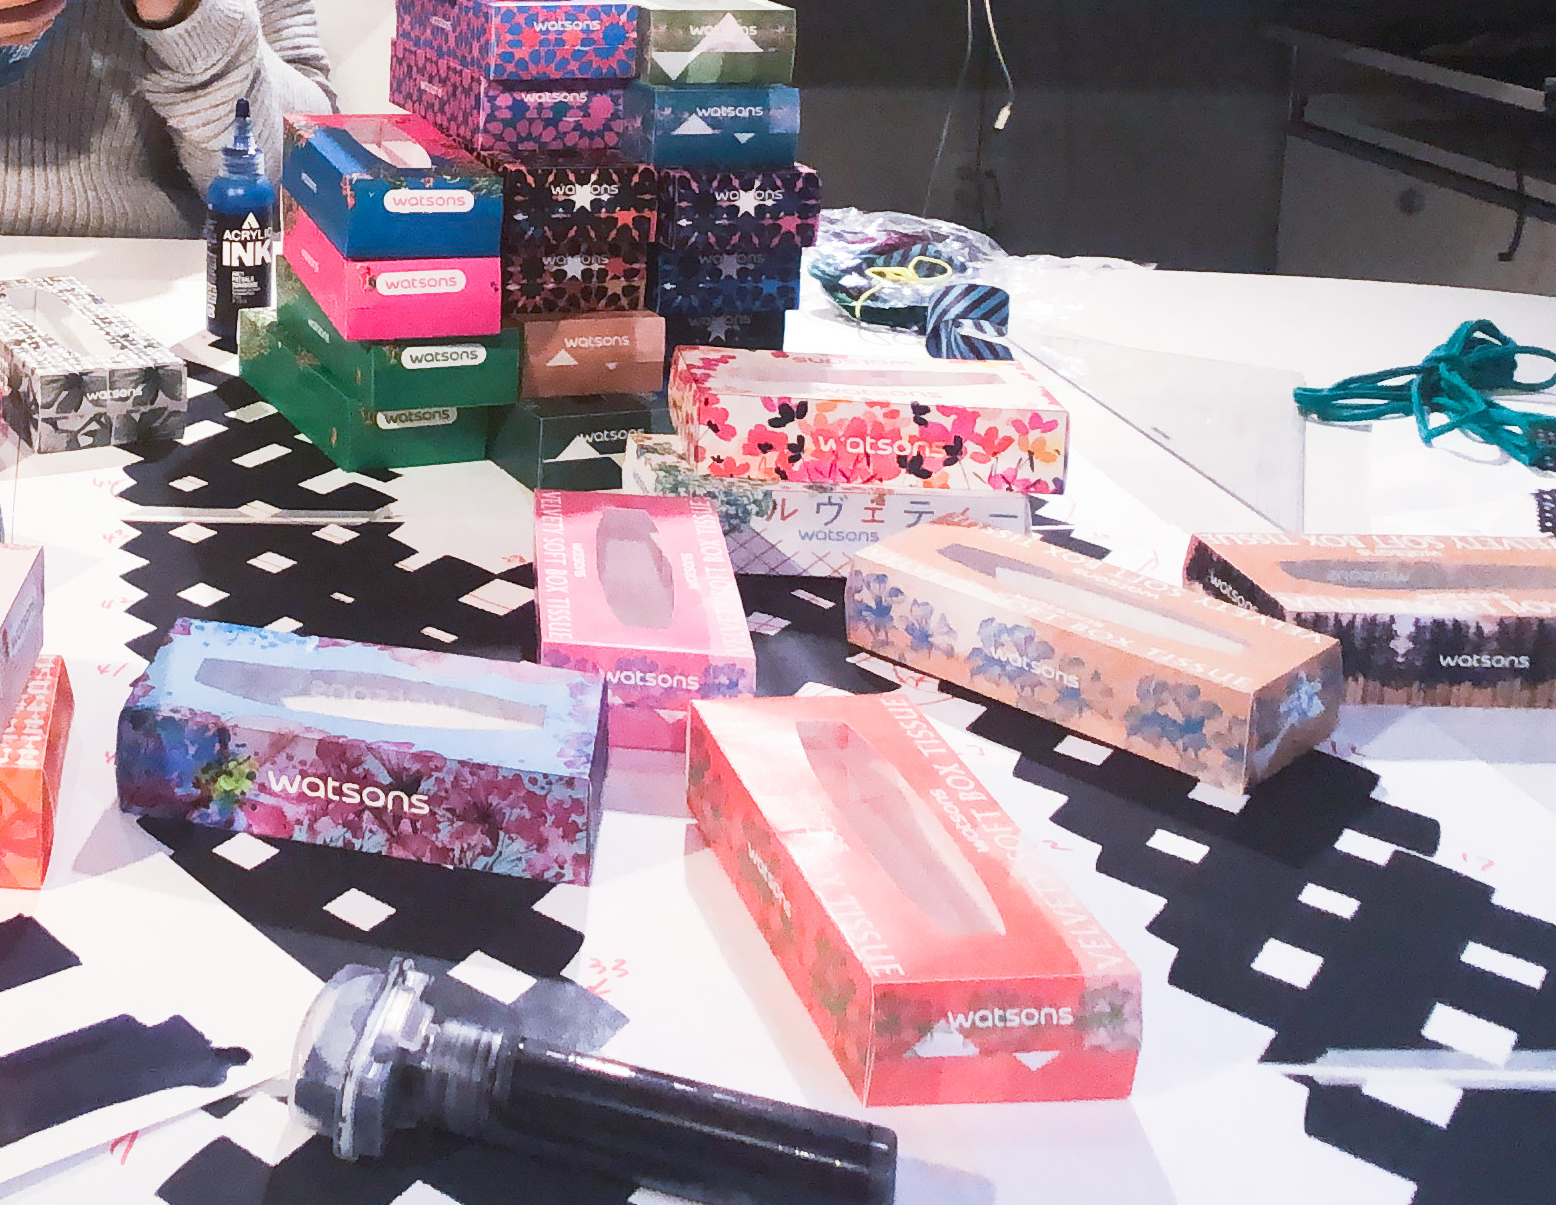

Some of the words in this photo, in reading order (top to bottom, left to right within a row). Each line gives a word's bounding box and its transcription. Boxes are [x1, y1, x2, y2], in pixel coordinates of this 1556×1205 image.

[534, 19, 601, 32] watsons
[522, 91, 588, 104] watsons
[696, 106, 764, 119] watsons
[391, 193, 466, 208] watsons
[222, 239, 272, 267] INK
[385, 275, 459, 291] watsons
[564, 335, 630, 349] watsons
[410, 348, 480, 364] watsons
[86, 384, 147, 401] watsons
[384, 407, 452, 424] watsons
[580, 429, 646, 444] watsons
[818, 435, 946, 458] watsons
[798, 529, 880, 543] watsons
[545, 567, 569, 596] BOX
[546, 597, 573, 640] TISSUE
[988, 646, 1081, 690] watsons
[1439, 653, 1531, 669] watsons
[934, 760, 989, 805] BOX
[267, 768, 432, 816] watsons
[588, 958, 630, 978] 33
[948, 1004, 1075, 1032] watsons
